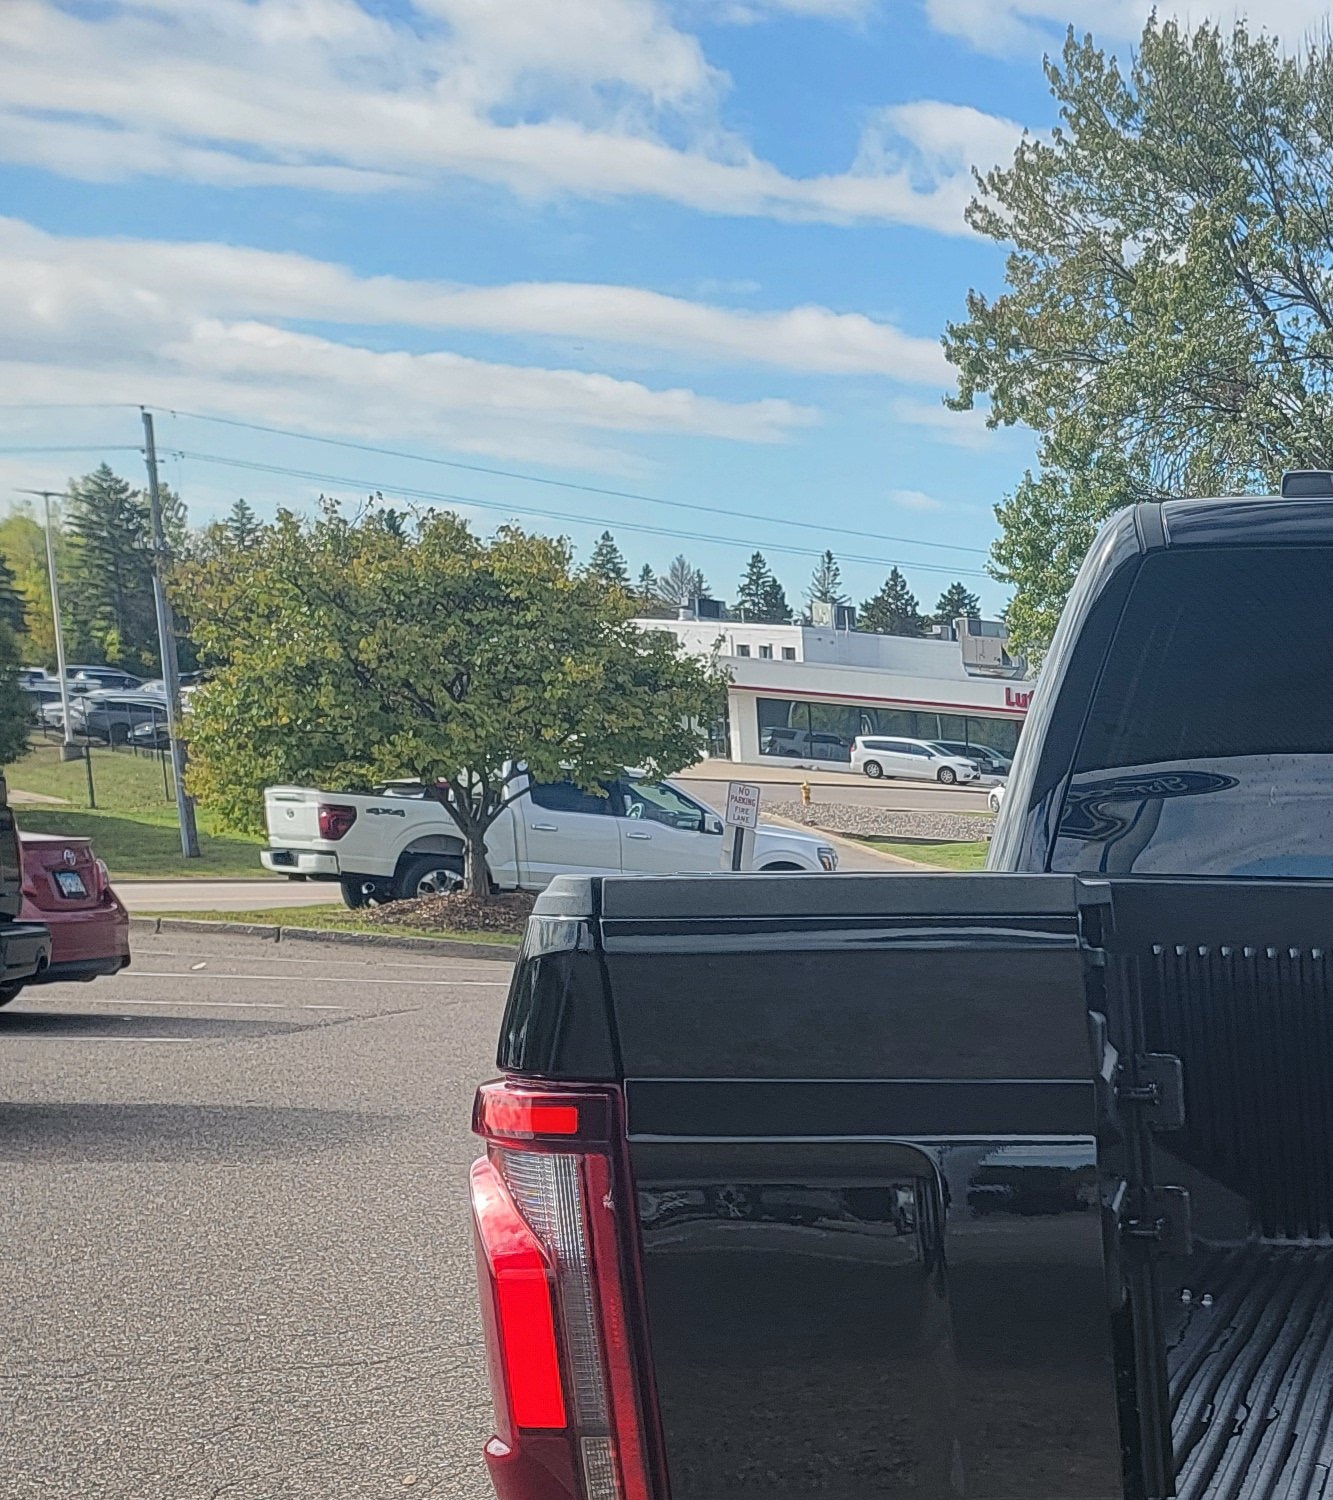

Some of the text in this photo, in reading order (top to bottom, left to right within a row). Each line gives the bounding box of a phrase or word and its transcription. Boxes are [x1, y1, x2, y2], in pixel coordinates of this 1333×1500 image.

[739, 787, 750, 796] NO
[731, 795, 755, 807] PARKING
[735, 806, 749, 815] FIRE
[733, 814, 749, 823] LANE
